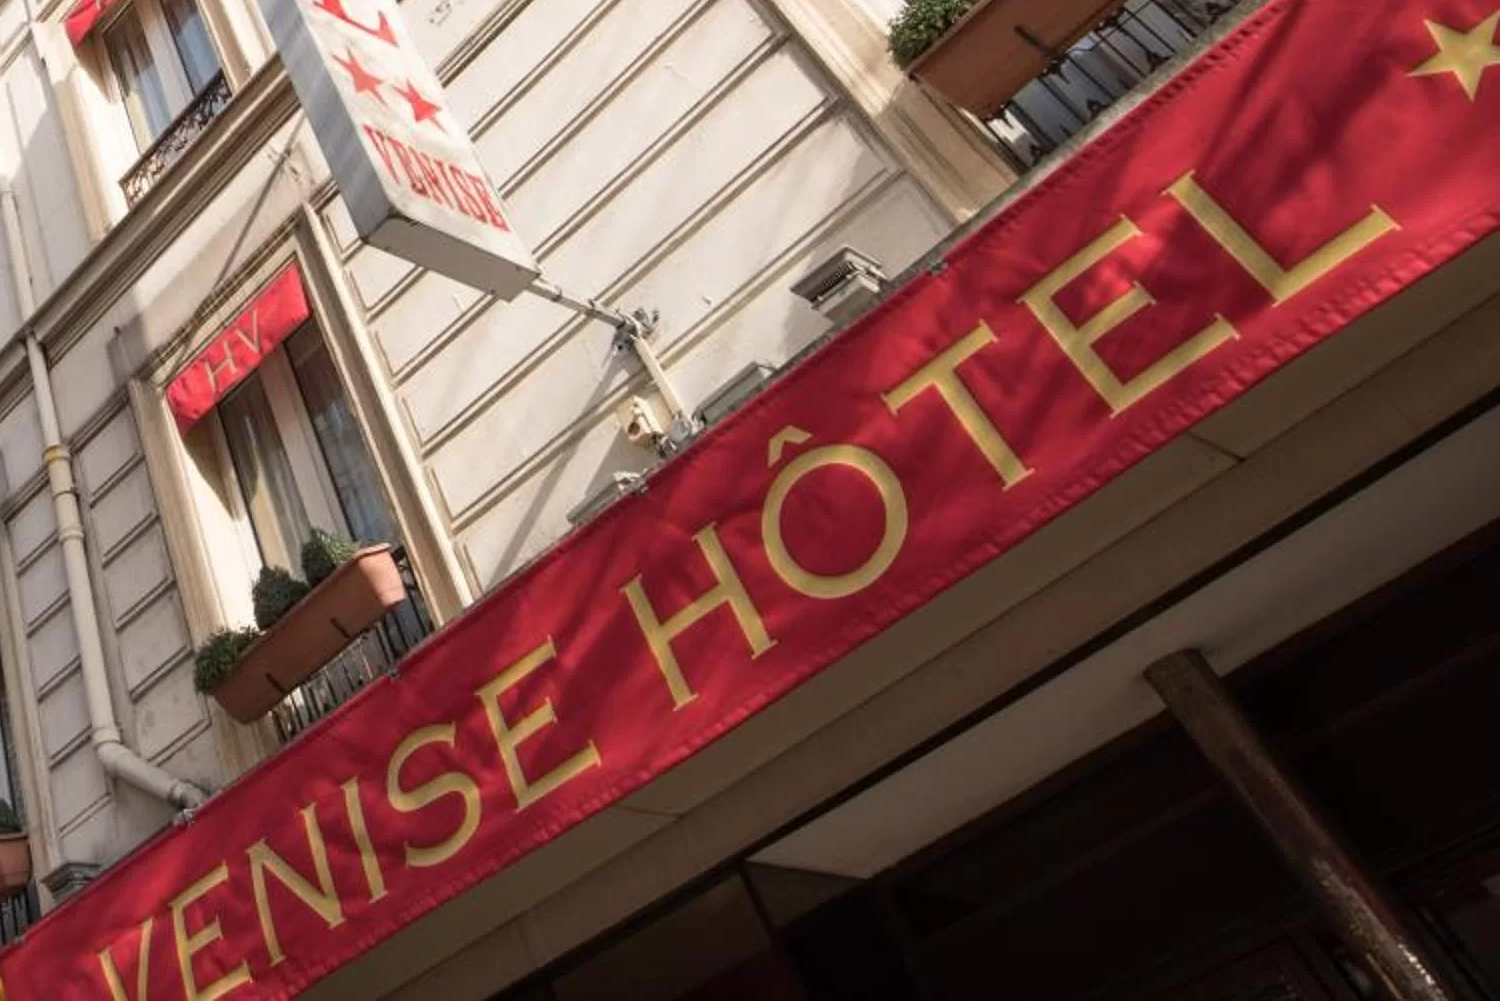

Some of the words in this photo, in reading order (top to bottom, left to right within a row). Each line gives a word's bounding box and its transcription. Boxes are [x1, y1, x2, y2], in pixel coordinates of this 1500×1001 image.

[362, 122, 512, 233] VENISE
[203, 309, 261, 392] HV
[98, 636, 603, 1001] VENISE
[619, 170, 1402, 712] HÔTEL
